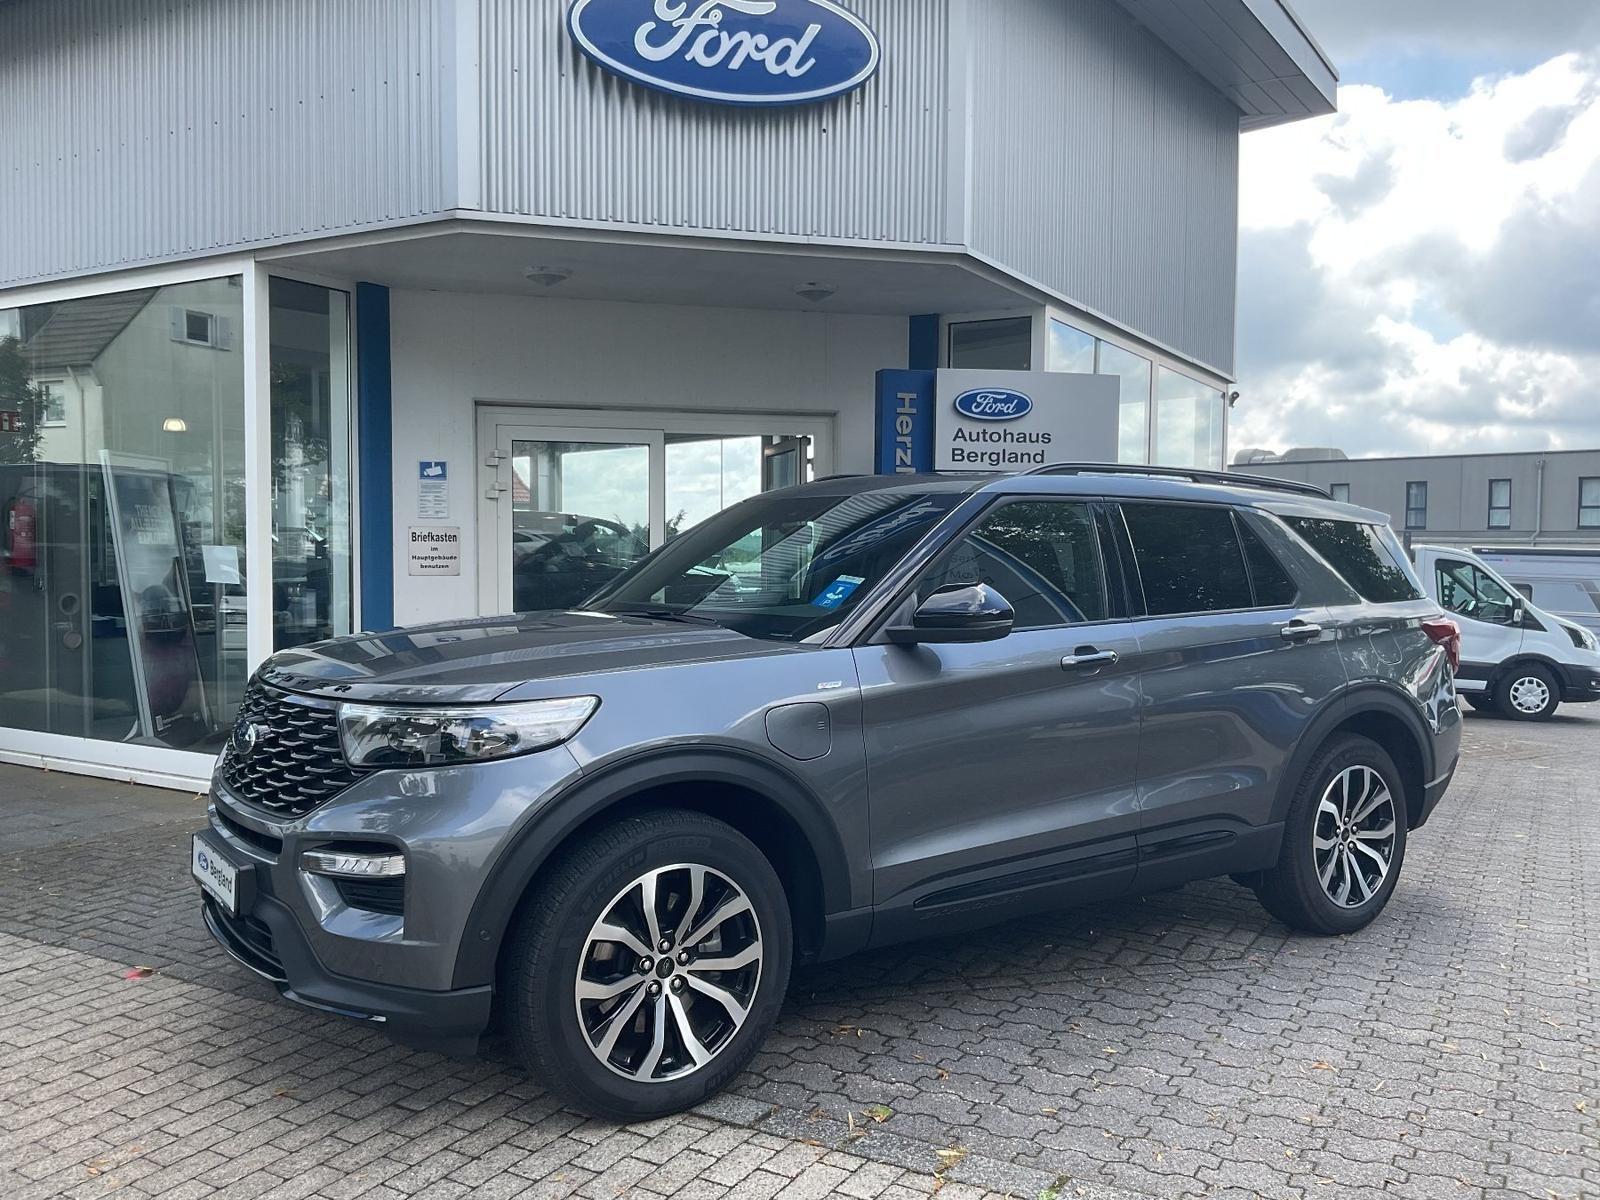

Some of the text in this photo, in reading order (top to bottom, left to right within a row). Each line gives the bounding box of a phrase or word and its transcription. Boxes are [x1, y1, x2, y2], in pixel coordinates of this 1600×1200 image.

[634, 0, 821, 77] Ford
[971, 392, 1018, 414] Ford
[952, 427, 1052, 444] Autohaus
[951, 447, 1045, 466] Bergland
[411, 531, 457, 543] Briefkasten
[210, 859, 233, 894] Bergland
